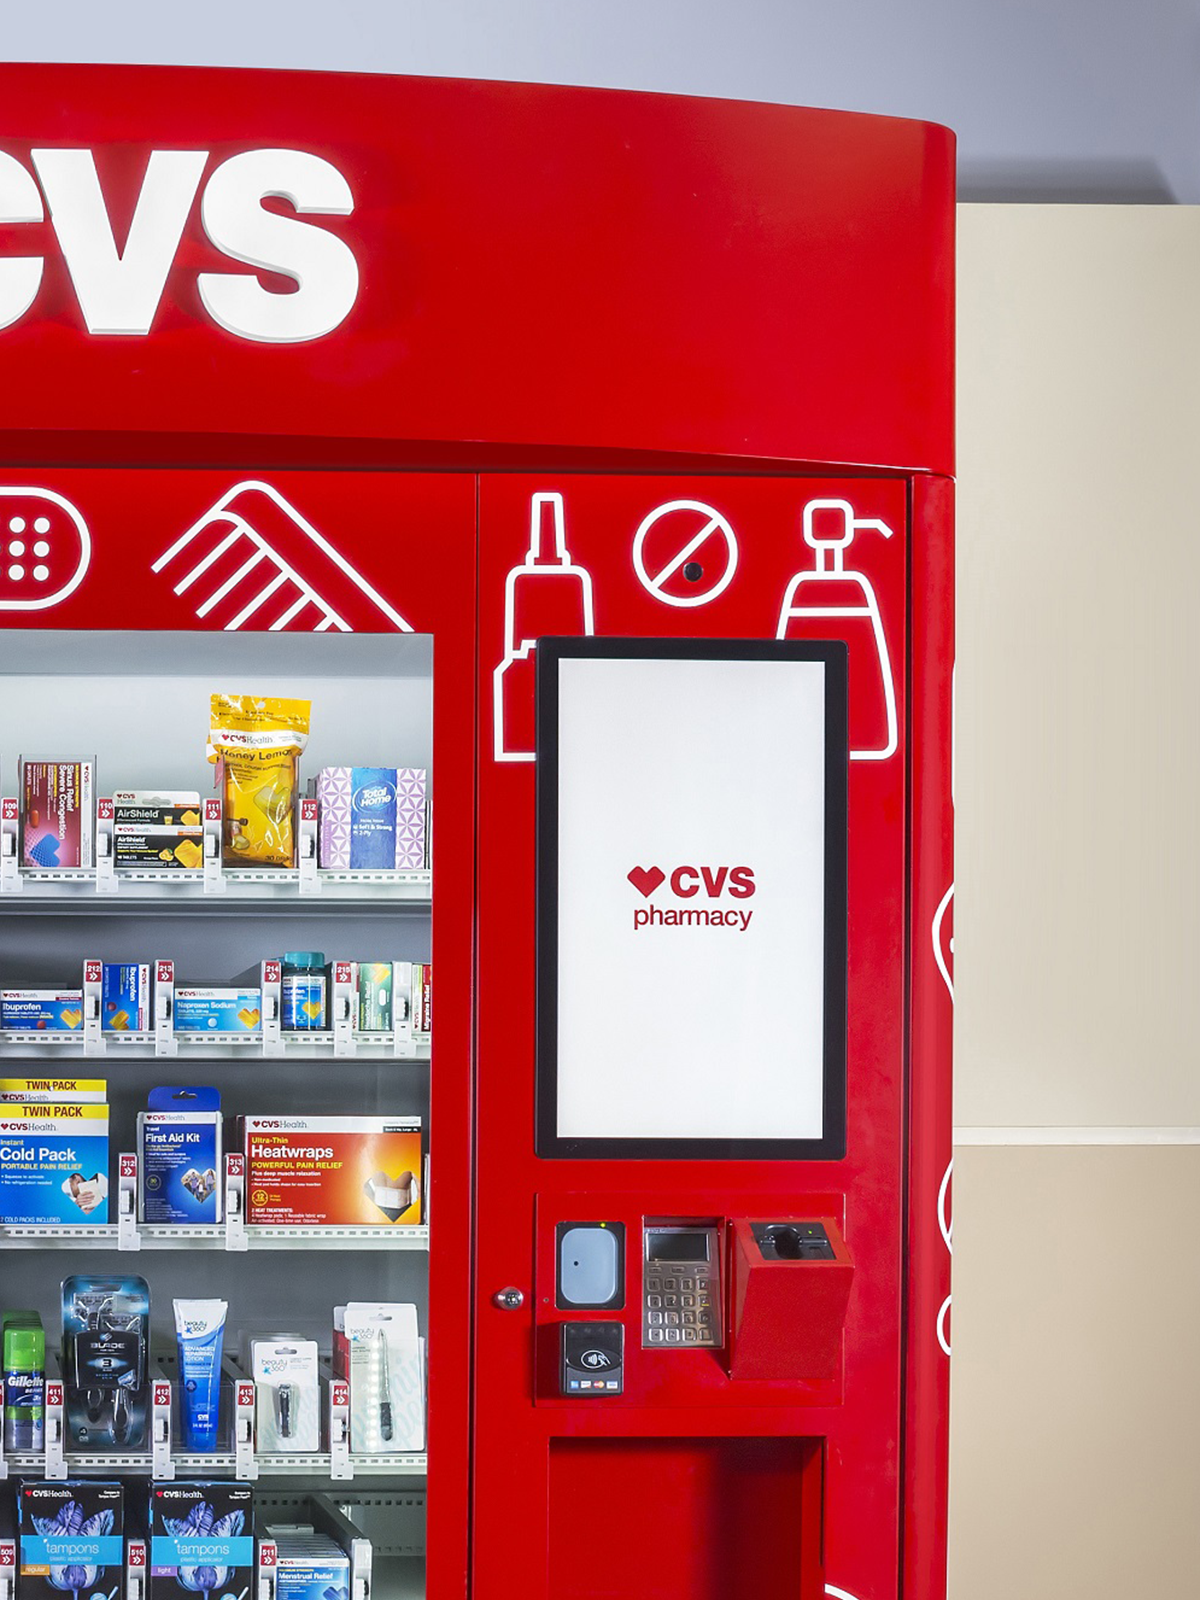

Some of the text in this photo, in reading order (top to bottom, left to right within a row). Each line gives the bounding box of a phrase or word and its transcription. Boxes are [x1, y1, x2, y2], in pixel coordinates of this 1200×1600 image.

[362, 787, 387, 798] Total
[100, 802, 113, 810] 110
[361, 795, 391, 807] Home
[58, 794, 66, 839] Congestion
[117, 809, 159, 819] AirShield
[117, 836, 146, 844] AirShield
[670, 866, 756, 898] CVS
[634, 904, 753, 931] pharmacy
[3, 1003, 41, 1011] Ibuprofen
[26, 1081, 76, 1090] TWIN PACK
[22, 1107, 82, 1117] TWIN PACK
[146, 1134, 200, 1143] First Aid Kit
[0, 1148, 76, 1161] Cold Pack
[252, 1145, 333, 1160] Heatwraps
[46, 1544, 99, 1556] tampons
[177, 1543, 229, 1556] tampons
[158, 1567, 171, 1575] light
